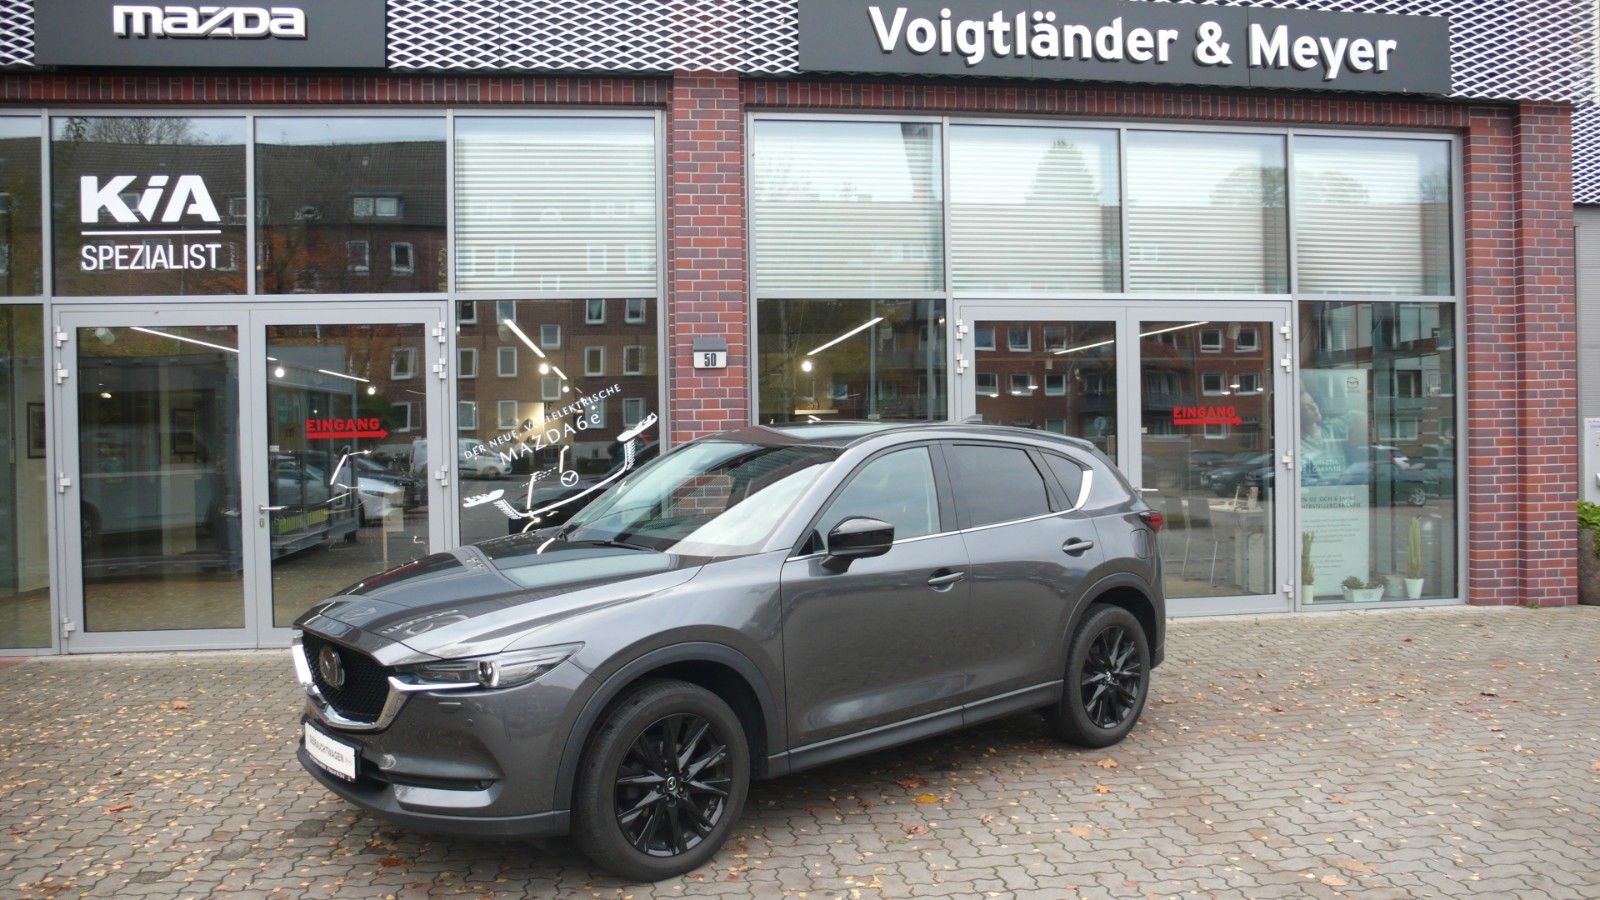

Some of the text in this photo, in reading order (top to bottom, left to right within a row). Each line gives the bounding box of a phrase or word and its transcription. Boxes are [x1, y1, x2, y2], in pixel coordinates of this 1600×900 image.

[868, 6, 1398, 80] Voigtländer & Meyer
[80, 243, 222, 271] SPEZIALIST
[704, 352, 717, 367] 50
[1173, 406, 1235, 417] EINGANG
[306, 417, 380, 432] EINGANG
[464, 444, 487, 460] DER
